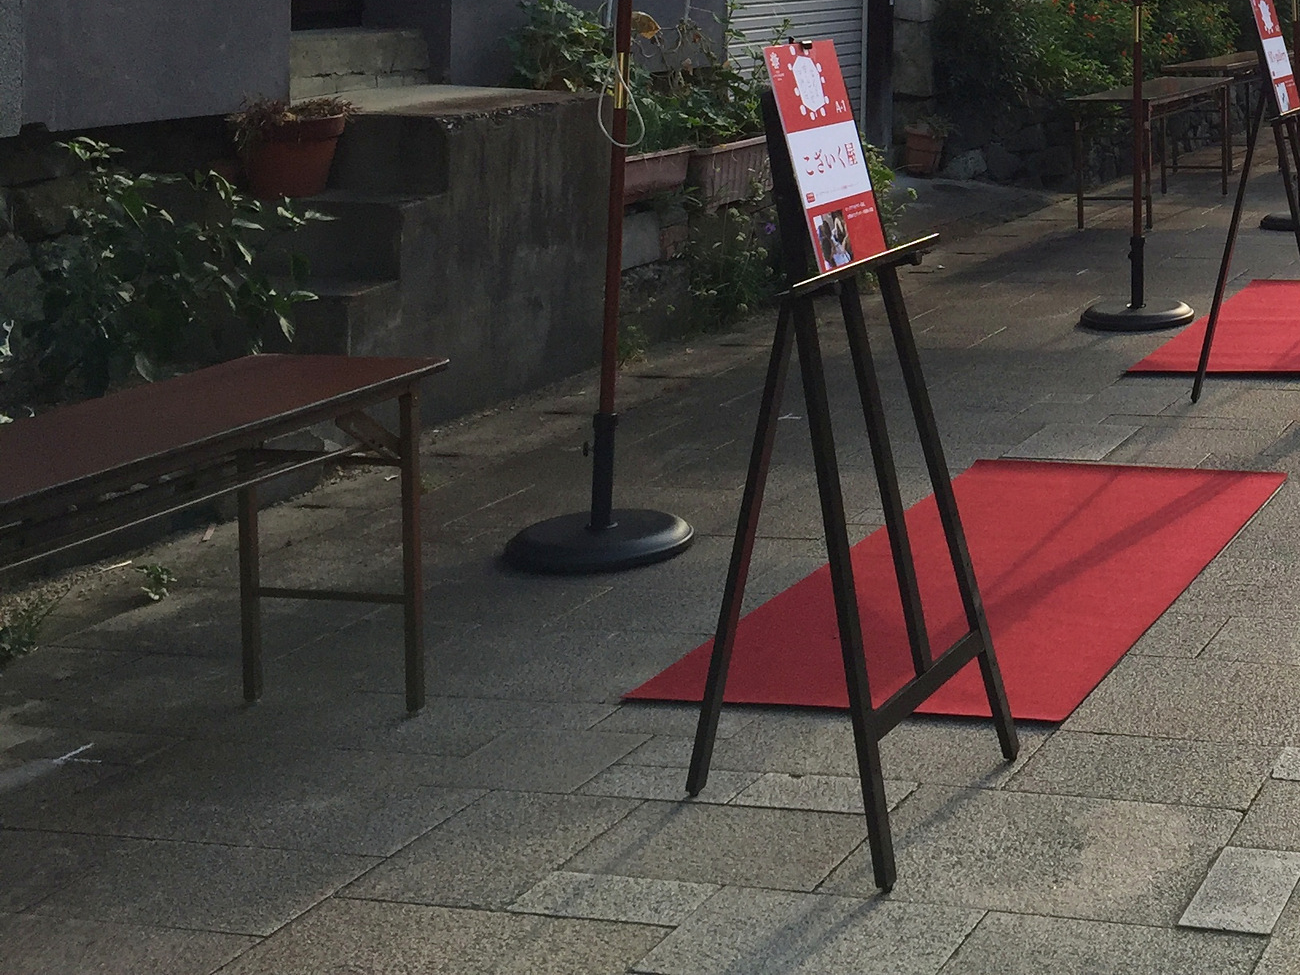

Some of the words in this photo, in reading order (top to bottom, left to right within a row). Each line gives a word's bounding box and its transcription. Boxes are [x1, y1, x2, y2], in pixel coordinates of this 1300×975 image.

[802, 142, 858, 176] こざいく屋
